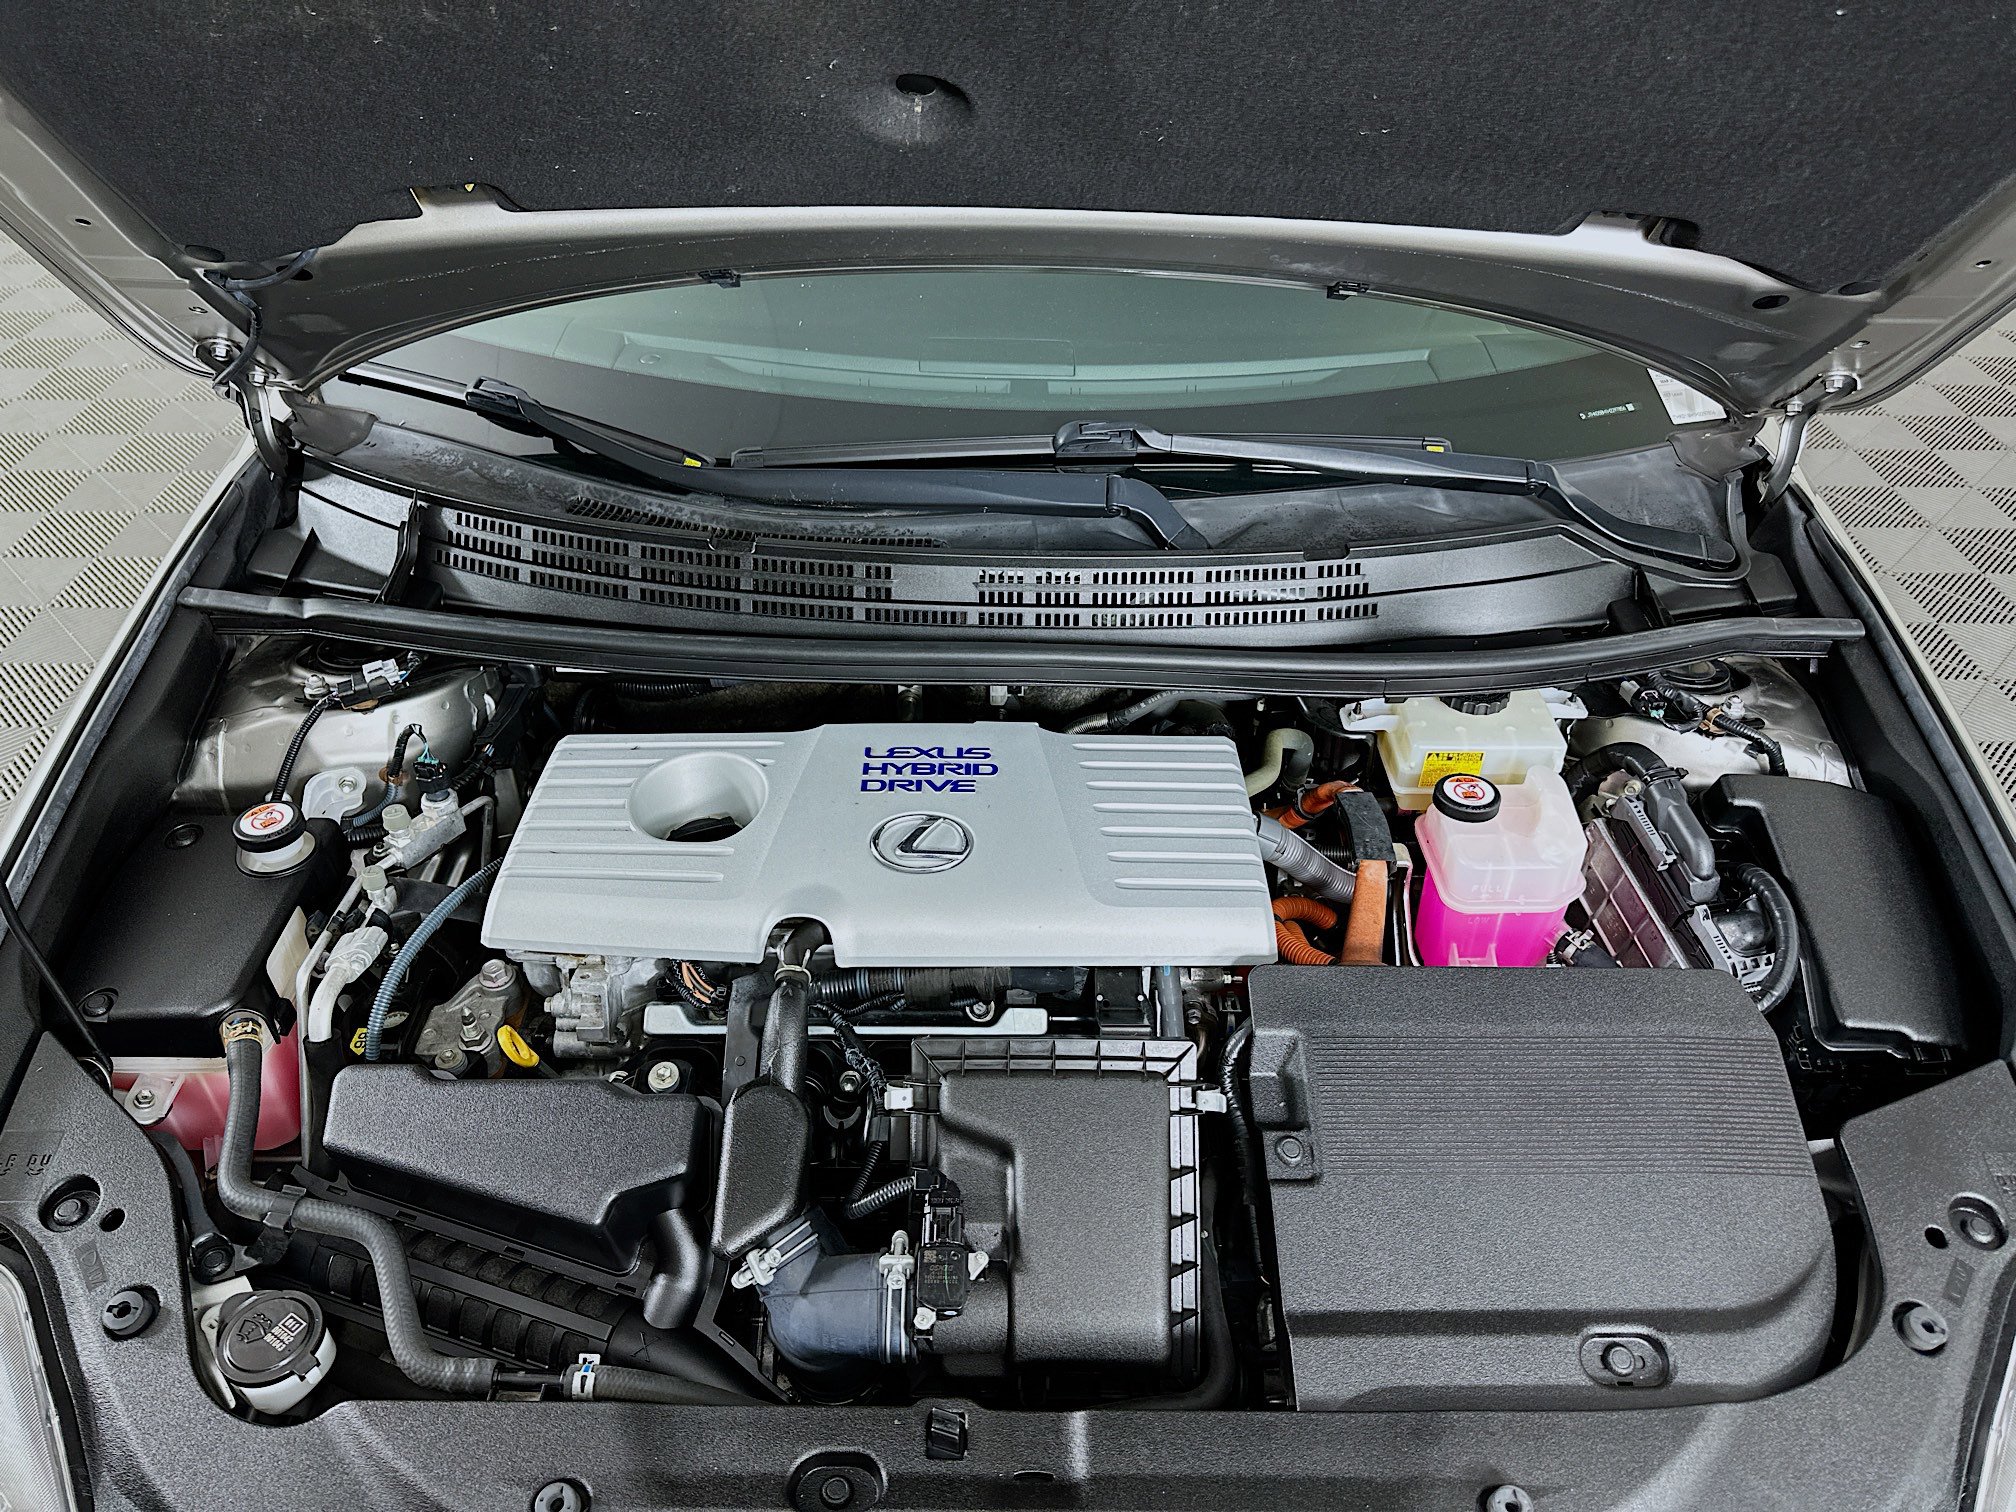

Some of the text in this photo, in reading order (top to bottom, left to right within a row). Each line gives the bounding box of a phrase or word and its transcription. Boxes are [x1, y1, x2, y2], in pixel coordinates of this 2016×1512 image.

[865, 747, 991, 759] LEXUS
[862, 763, 998, 775] HYBRID
[861, 780, 976, 792] DRIVE
[1471, 884, 1502, 893] FULL
